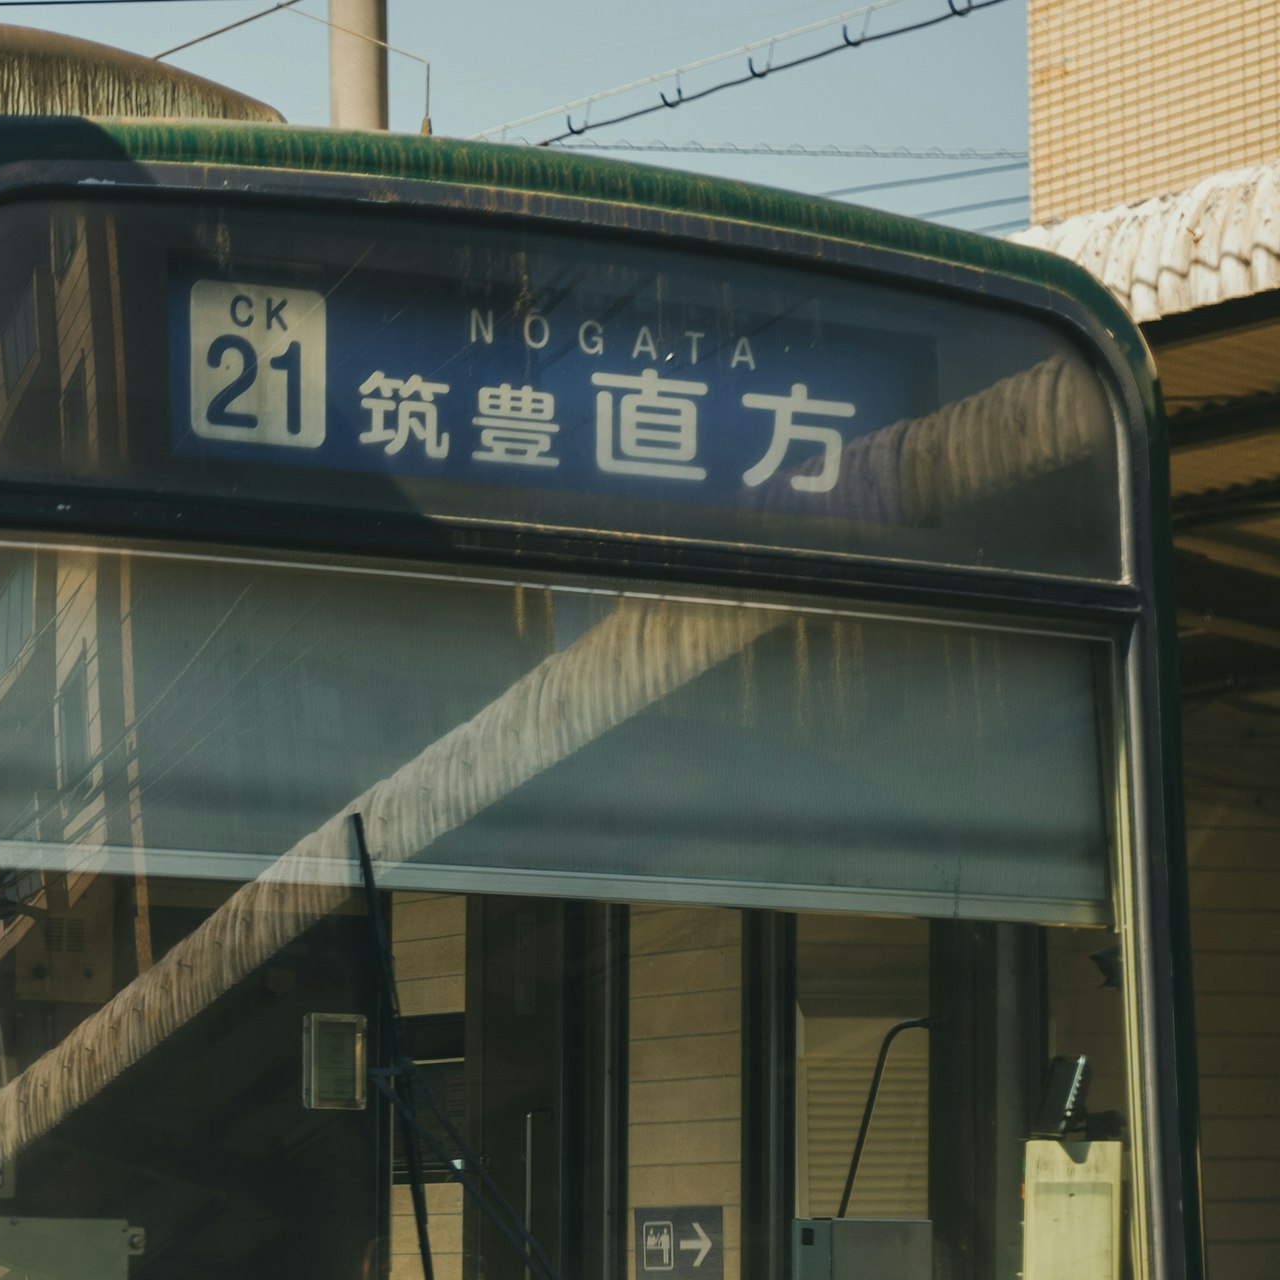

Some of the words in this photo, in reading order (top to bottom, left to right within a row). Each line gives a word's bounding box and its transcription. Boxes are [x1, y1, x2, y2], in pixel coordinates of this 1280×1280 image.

[229, 293, 288, 332] CK
[205, 334, 305, 436] 21
[358, 368, 856, 493] 筑豊直方
